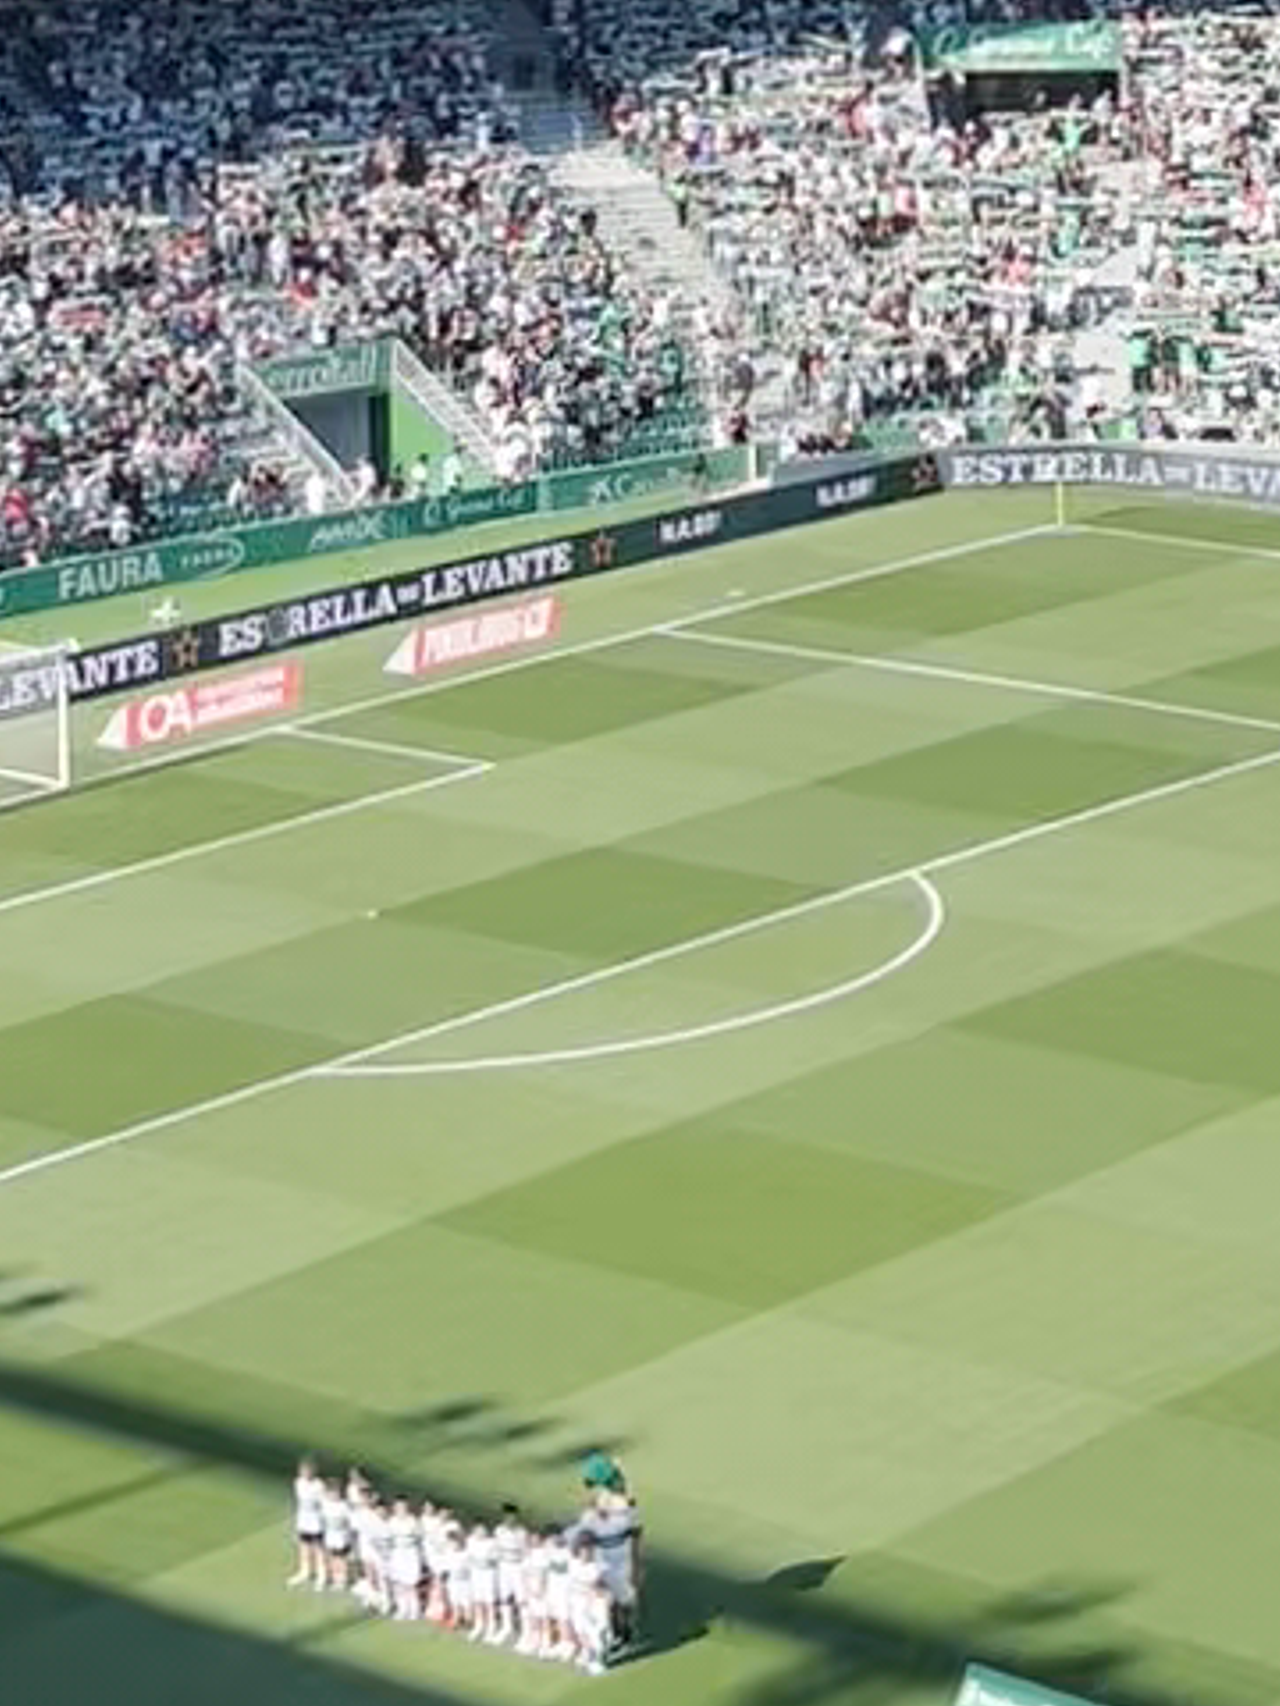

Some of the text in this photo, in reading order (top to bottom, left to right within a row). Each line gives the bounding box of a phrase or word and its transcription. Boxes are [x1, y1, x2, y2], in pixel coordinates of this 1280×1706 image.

[951, 450, 1163, 488] ESTRELLA
[58, 553, 163, 599] FAURA
[220, 584, 398, 656] ESRELLA
[419, 540, 574, 605] LEVANTE
